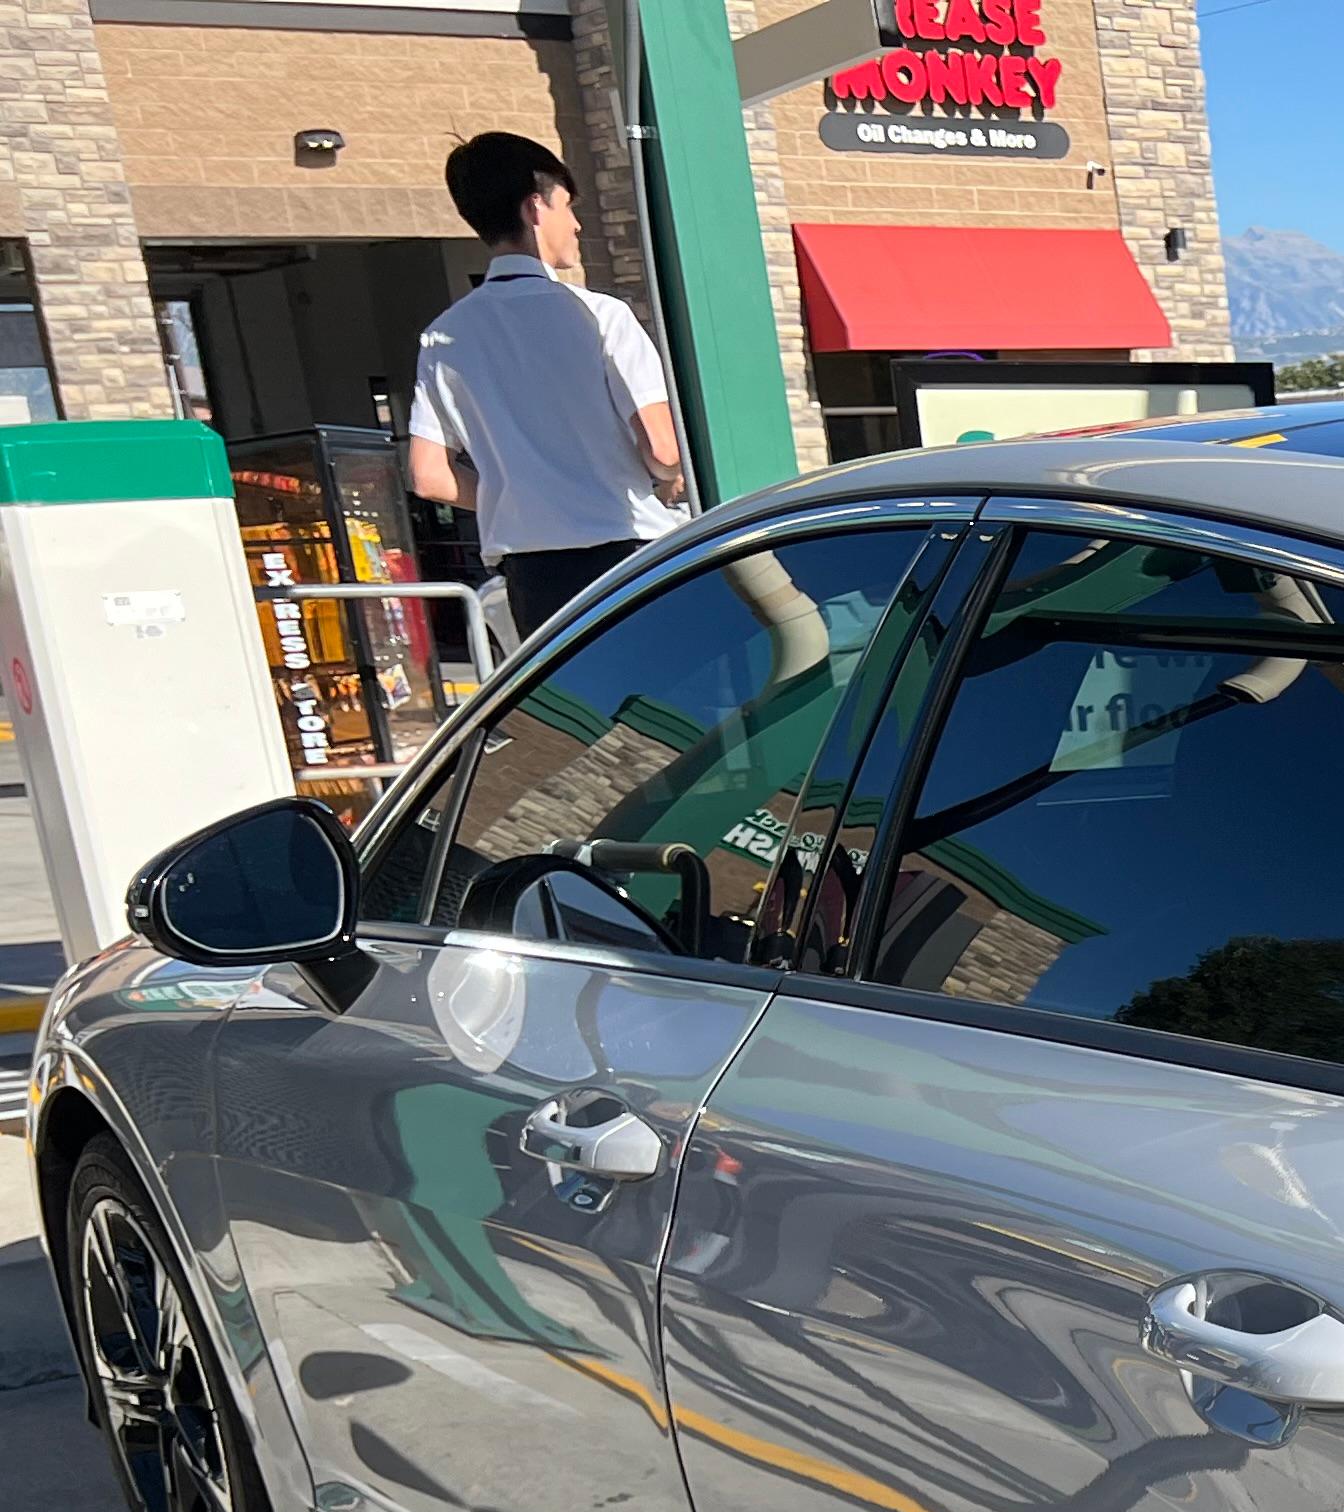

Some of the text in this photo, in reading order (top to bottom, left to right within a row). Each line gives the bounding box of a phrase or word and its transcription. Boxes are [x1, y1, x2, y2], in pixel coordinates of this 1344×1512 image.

[896, 0, 1046, 46] EASE
[832, 48, 1062, 109] MONKEY
[857, 123, 1036, 149] Oil Changes & More
[262, 553, 310, 669] EXRESS
